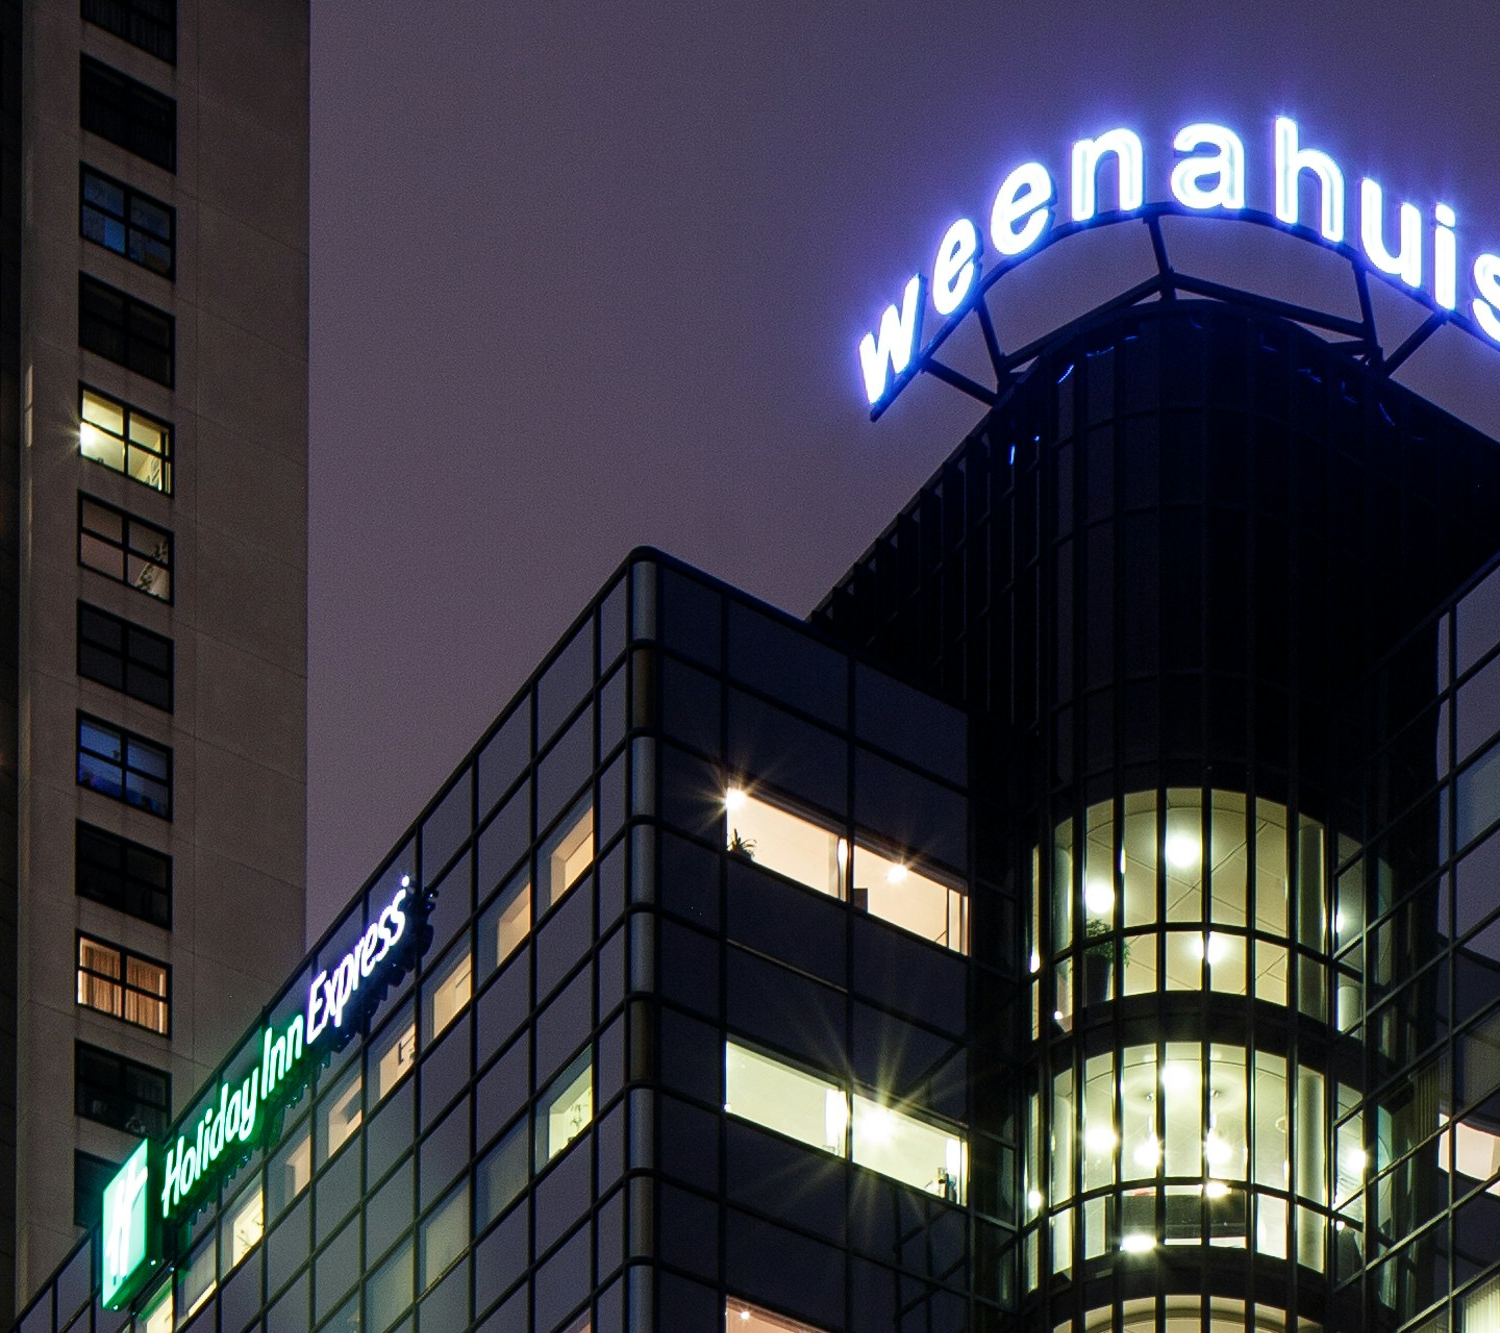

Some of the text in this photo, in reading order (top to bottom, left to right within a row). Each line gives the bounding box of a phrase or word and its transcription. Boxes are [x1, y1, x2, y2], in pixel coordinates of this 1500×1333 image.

[161, 888, 408, 1218] Holiday Inn Express
